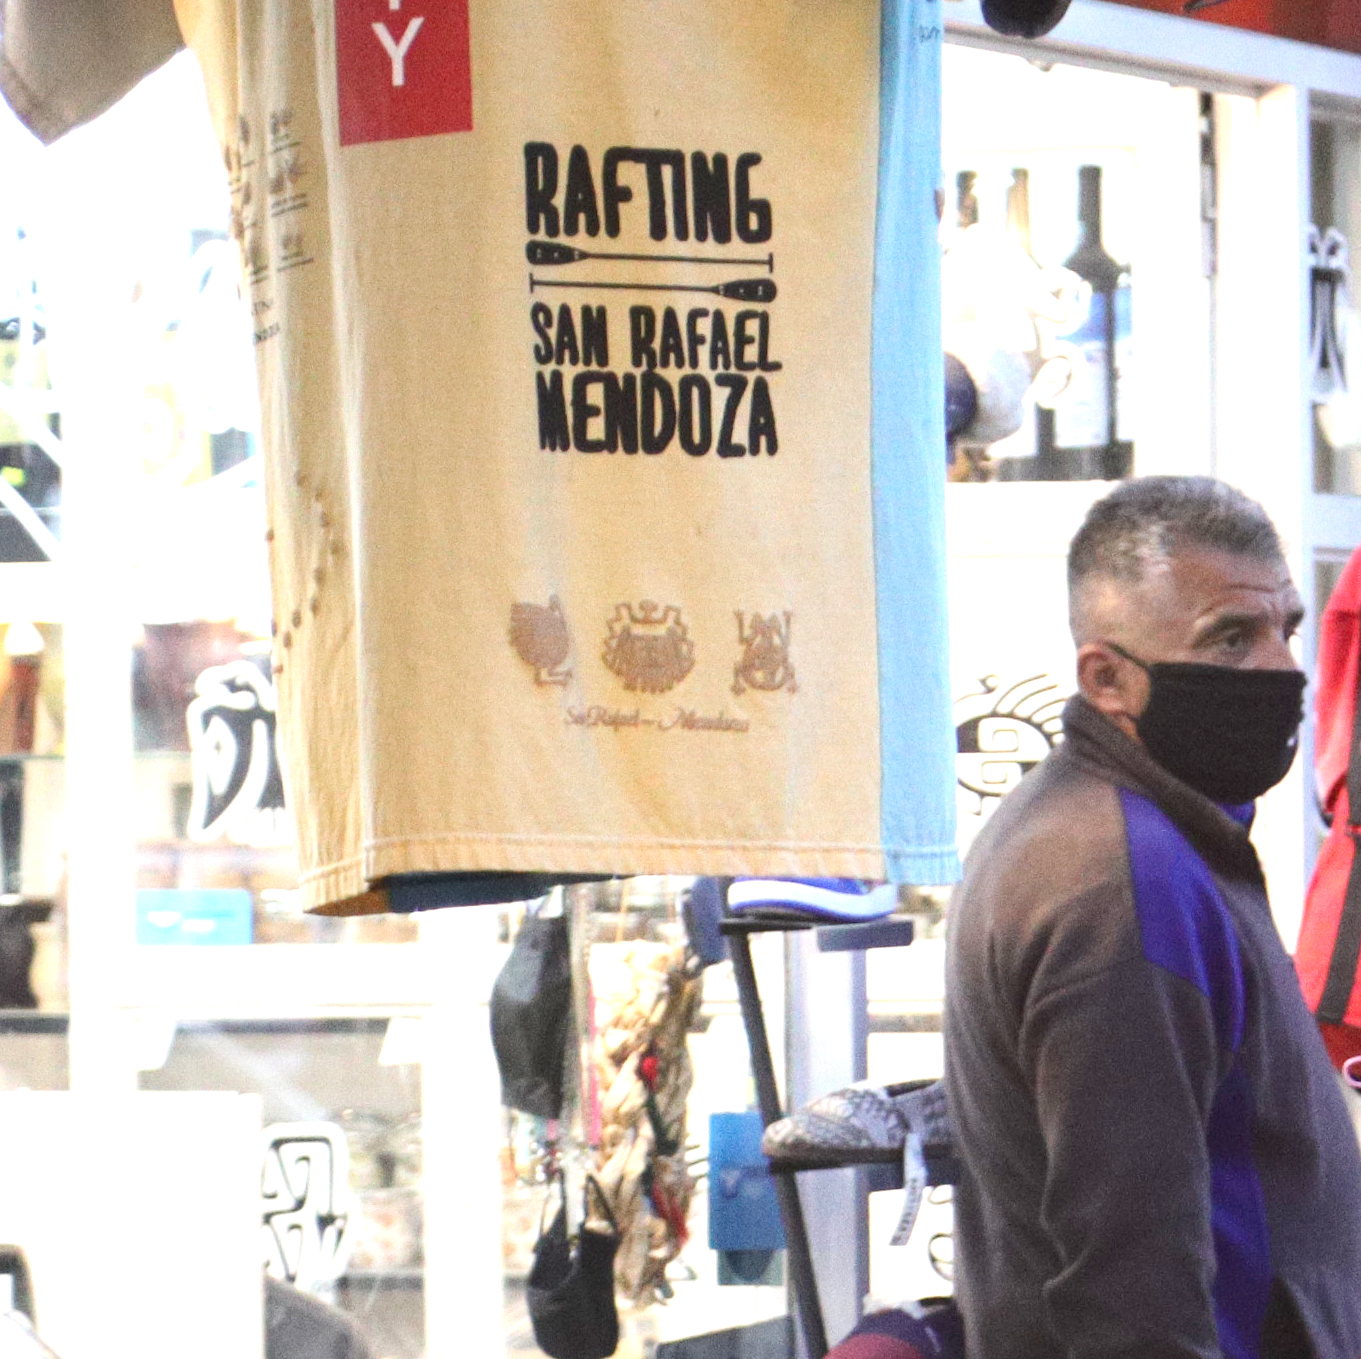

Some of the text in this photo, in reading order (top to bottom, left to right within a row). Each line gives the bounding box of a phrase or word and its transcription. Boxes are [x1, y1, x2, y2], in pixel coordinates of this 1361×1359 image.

[523, 140, 773, 244] RAFTING
[530, 301, 783, 372] SAN RAFAEL
[535, 368, 779, 458] MENDOZA
